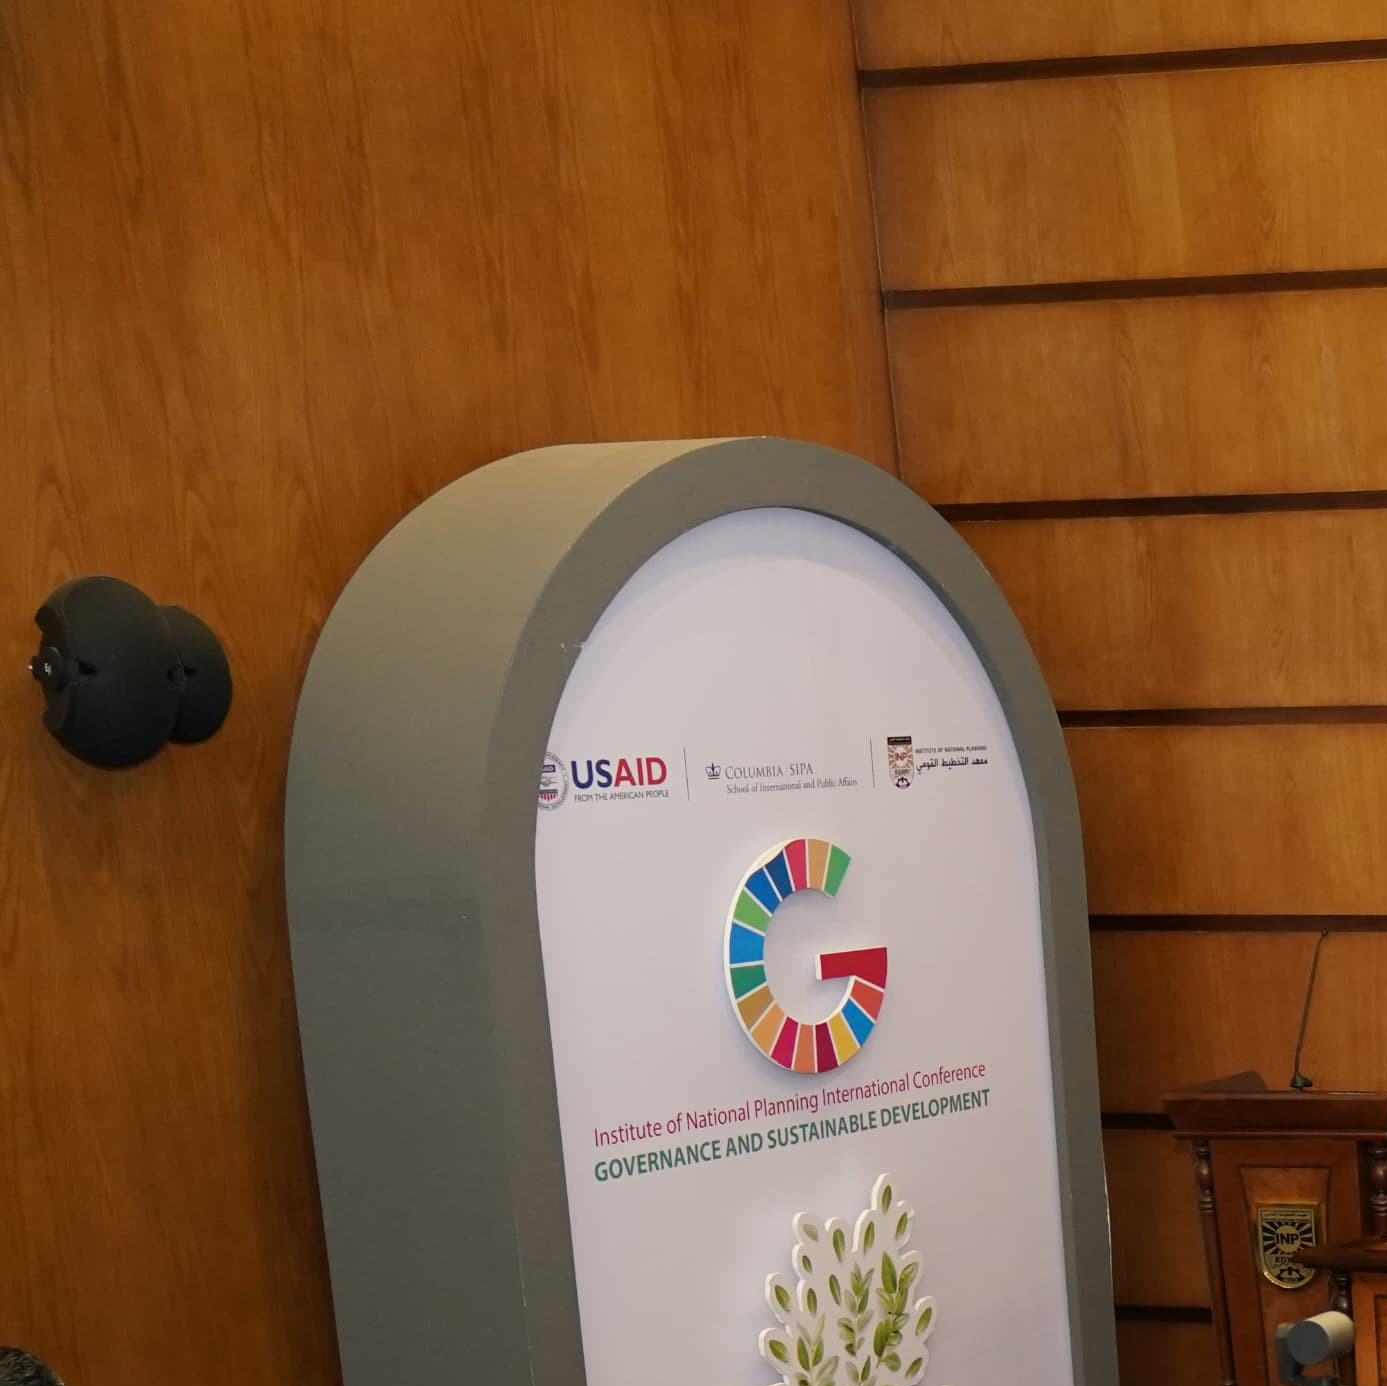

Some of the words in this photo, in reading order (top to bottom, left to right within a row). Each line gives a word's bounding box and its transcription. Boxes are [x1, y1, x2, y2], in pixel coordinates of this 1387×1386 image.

[725, 765, 784, 780] COLUMBIA
[789, 762, 814, 776] SIPA
[916, 758, 939, 775] القومي
[941, 756, 969, 770] التخطيط
[571, 756, 667, 789] USAID
[727, 783, 750, 794] School
[751, 782, 758, 793] of
[759, 779, 802, 792] International
[803, 778, 816, 789] and
[817, 777, 837, 788] Public
[838, 776, 858, 787] Affairs
[574, 793, 594, 803] FROM
[595, 792, 609, 801] THE
[609, 790, 644, 801] AMERICAN
[645, 789, 669, 799] PEOPLE
[594, 1121, 662, 1147] Institute
[666, 1112, 683, 1135] of
[686, 1101, 750, 1132] National
[754, 1093, 819, 1118] Planning
[822, 1072, 910, 1106] International
[913, 1063, 986, 1089] Conference
[594, 1140, 722, 1182] GOVERNANCE
[726, 1132, 763, 1157] AND
[767, 1110, 878, 1149] SUSTAINABLE
[881, 1088, 990, 1127] DEVELOPMENT
[1276, 1233, 1299, 1245] INP
